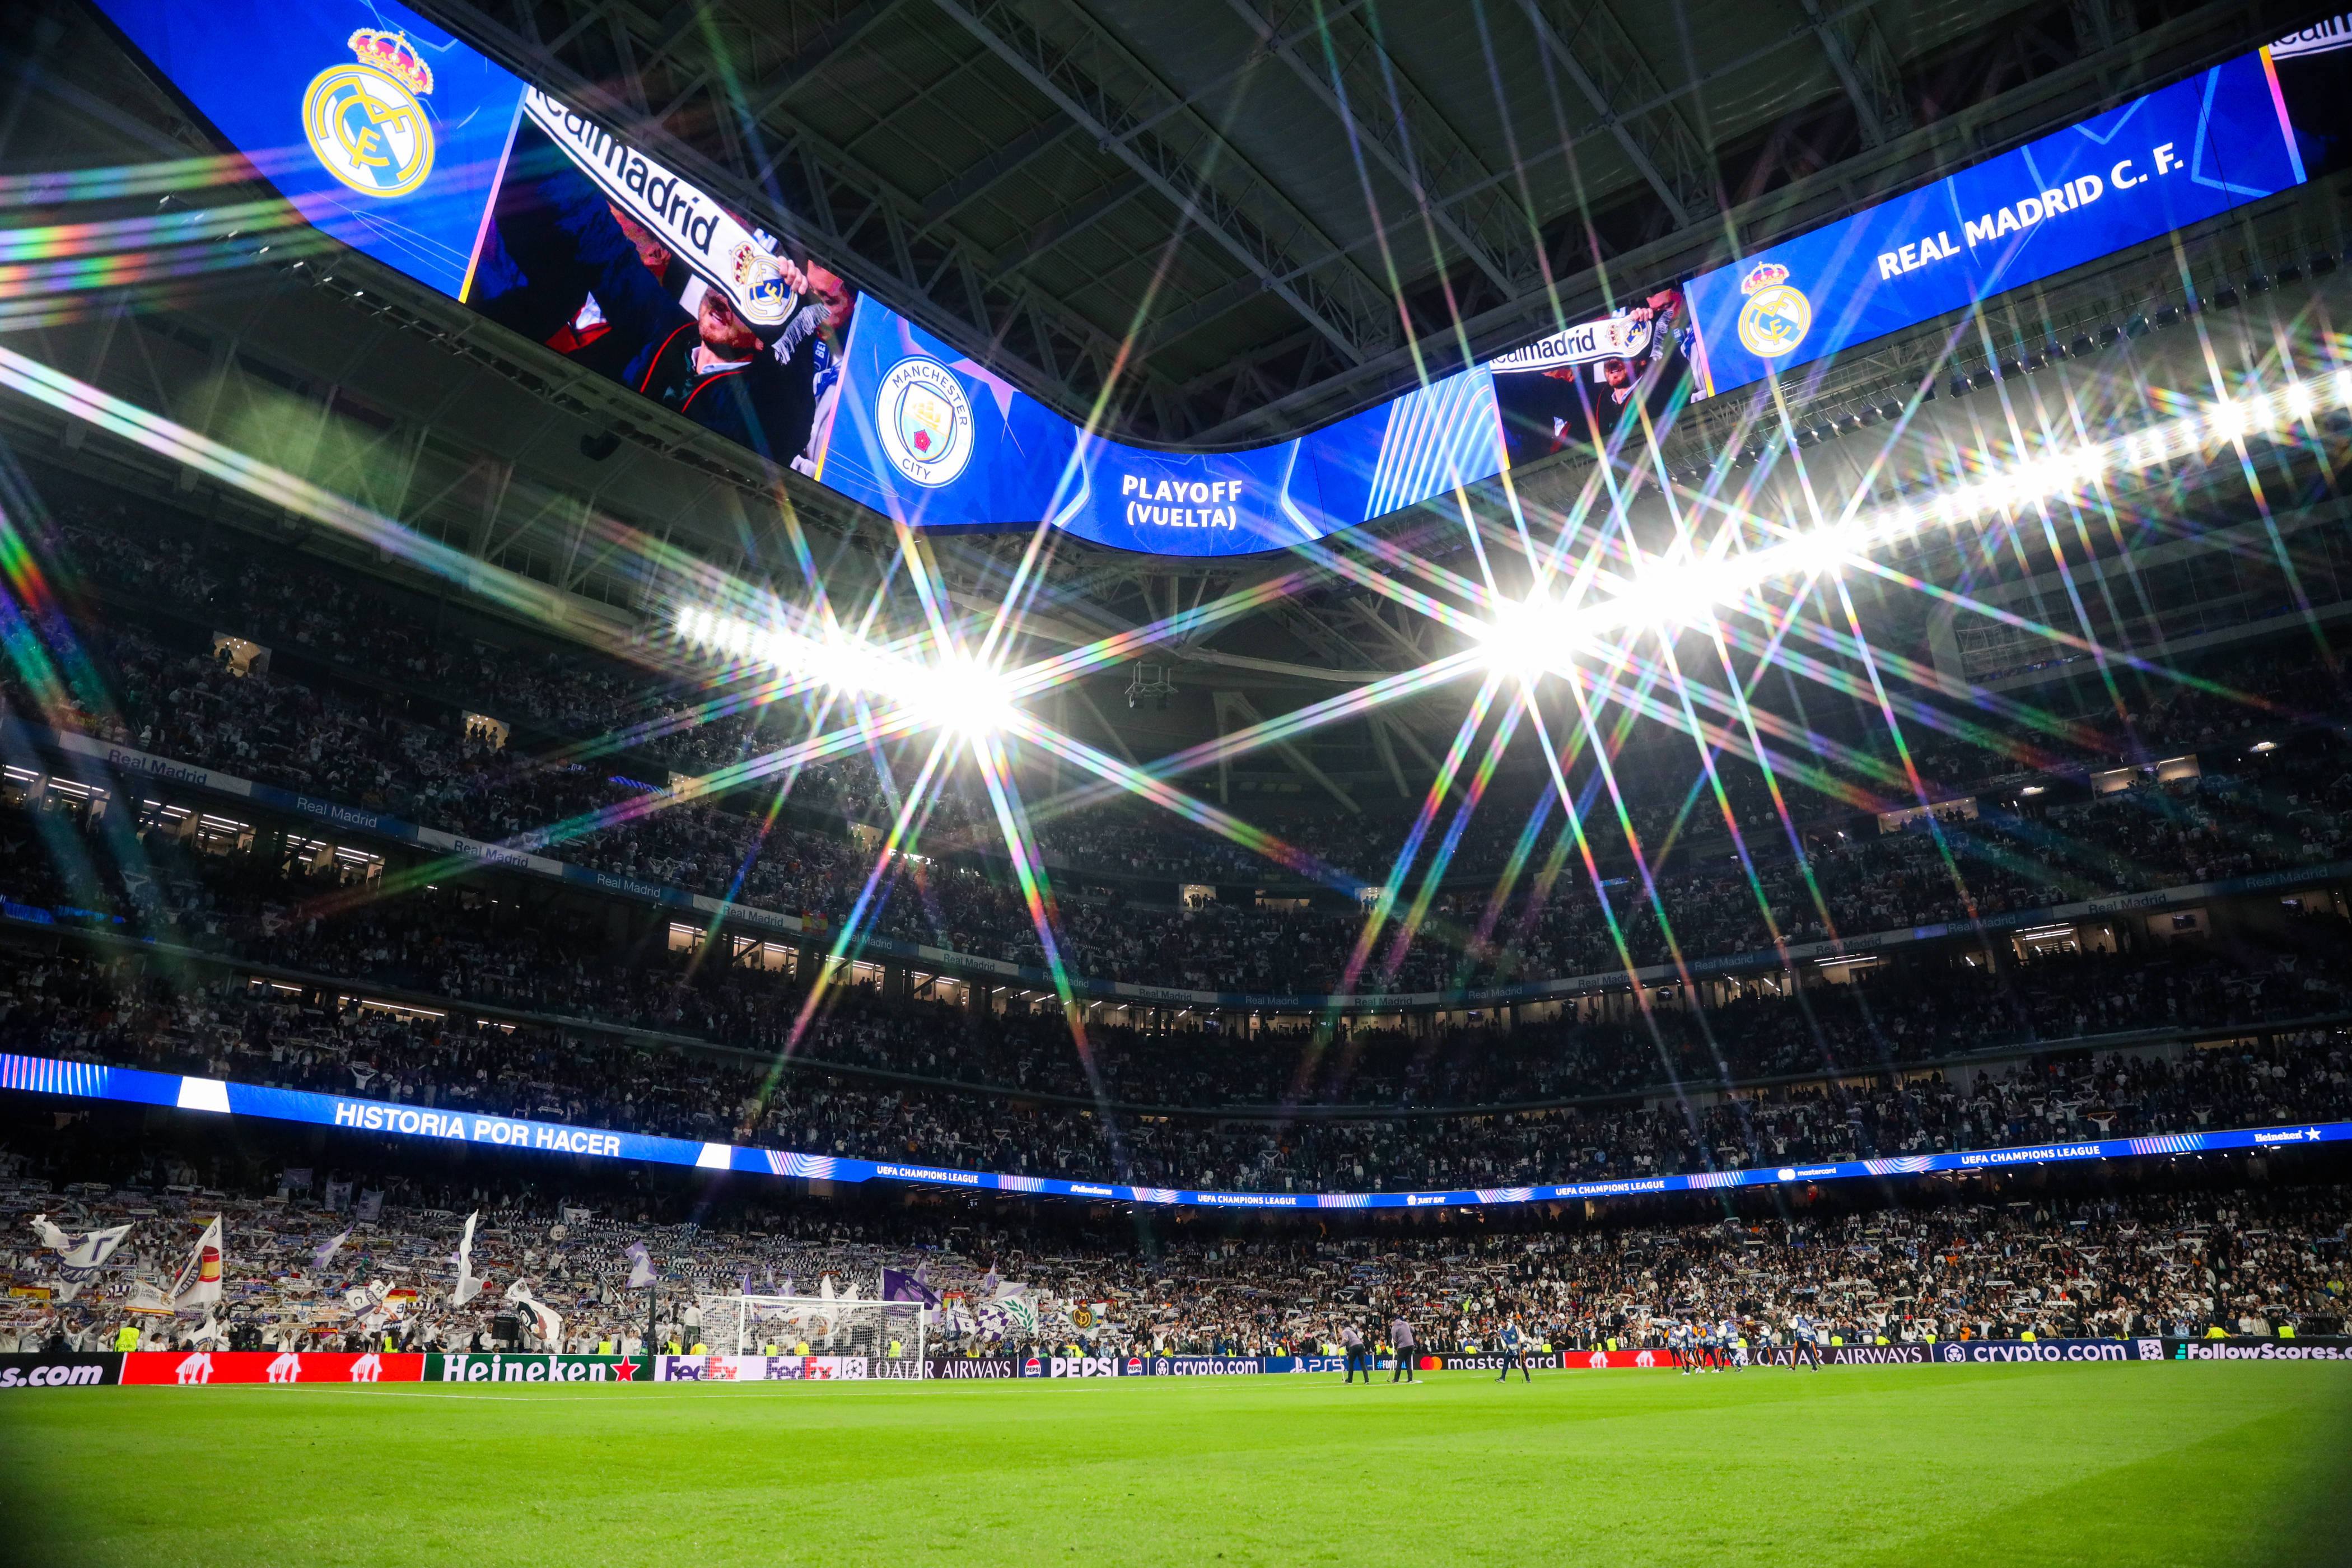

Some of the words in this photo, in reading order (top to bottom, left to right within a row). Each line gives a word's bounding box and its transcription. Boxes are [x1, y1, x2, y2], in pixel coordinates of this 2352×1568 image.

[1878, 231, 1961, 281] REAL
[1965, 175, 2104, 248] MADRID
[2111, 160, 2148, 189] C.
[2153, 142, 2184, 175] F.
[892, 366, 968, 426] MANCHESTER
[902, 458, 931, 480] CITY
[1122, 474, 1242, 503] PLAYOFF
[1127, 501, 1236, 530] (VUELTA)
[109, 749, 147, 770] Real
[151, 760, 207, 785] Madrid
[297, 797, 328, 817] Real
[332, 806, 377, 828] Madrid
[454, 840, 483, 856] Real
[486, 847, 529, 868] Madrid
[596, 874, 621, 889] Real
[624, 880, 661, 898] Madrid
[2246, 875, 2275, 889] Real
[2089, 902, 2118, 914] Real
[2121, 894, 2166, 909] Madrid
[722, 905, 746, 919] Real
[748, 912, 783, 928] Madrid
[1948, 920, 1975, 934] Real
[1979, 914, 2015, 929] Madrid
[861, 935, 892, 950] Madrid
[1816, 941, 1841, 954] Real
[1844, 936, 1882, 950] Madrid
[944, 953, 959, 964] Real
[961, 956, 995, 972] Madrid
[1695, 959, 1716, 971] Real
[1719, 955, 1754, 967] Madrid
[1043, 972, 1058, 984] Real
[1578, 978, 1600, 988] Real
[1604, 973, 1636, 986] Madrid
[1140, 988, 1159, 999] Real
[1162, 991, 1192, 1001] Madrid
[1245, 996, 1264, 1005] Real
[1267, 995, 1299, 1006] Madrid
[1355, 996, 1378, 1006] Real
[1380, 996, 1412, 1006] Madrid
[1468, 990, 1487, 1000] Real
[1490, 986, 1523, 997] Madrid
[335, 1103, 465, 1139] HISTORIA
[473, 1122, 529, 1146] POR
[536, 1127, 620, 1156] HACER
[2255, 1130, 2303, 1142] Heineken
[1962, 1155, 1989, 1165] UEFA
[1991, 1149, 2055, 1163] CHAMPIONS
[2057, 1146, 2101, 1158] LEAGUE
[877, 1165, 898, 1177] UEFA
[899, 1168, 947, 1181] CHAMPIONS
[949, 1172, 978, 1184] LEAGUE
[1797, 1167, 1837, 1177] mastercard
[1556, 1186, 1577, 1196] UEFA
[1578, 1183, 1629, 1194] CHAMPIONS
[1631, 1180, 1664, 1191] LEAGUE
[1198, 1194, 1216, 1204] UEFA
[1217, 1195, 1263, 1205] CHAMPIONS
[1265, 1196, 1296, 1205] LEAGUE
[382, 1322, 402, 1330] MBAPP
[1834, 1346, 1922, 1364] AIRWAYS
[1973, 1342, 2127, 1362] crypto.com
[442, 1355, 606, 1382] Heineken
[665, 1356, 738, 1381] FedEx
[766, 1356, 833, 1380] FedEx
[875, 1360, 934, 1379] QATAR
[942, 1360, 1011, 1378] AIRWAYS
[1051, 1357, 1118, 1377] PEPSI
[1173, 1360, 1258, 1375] crypto.com
[1309, 1359, 1345, 1373] PS5
[0, 1364, 103, 1388] s.com
